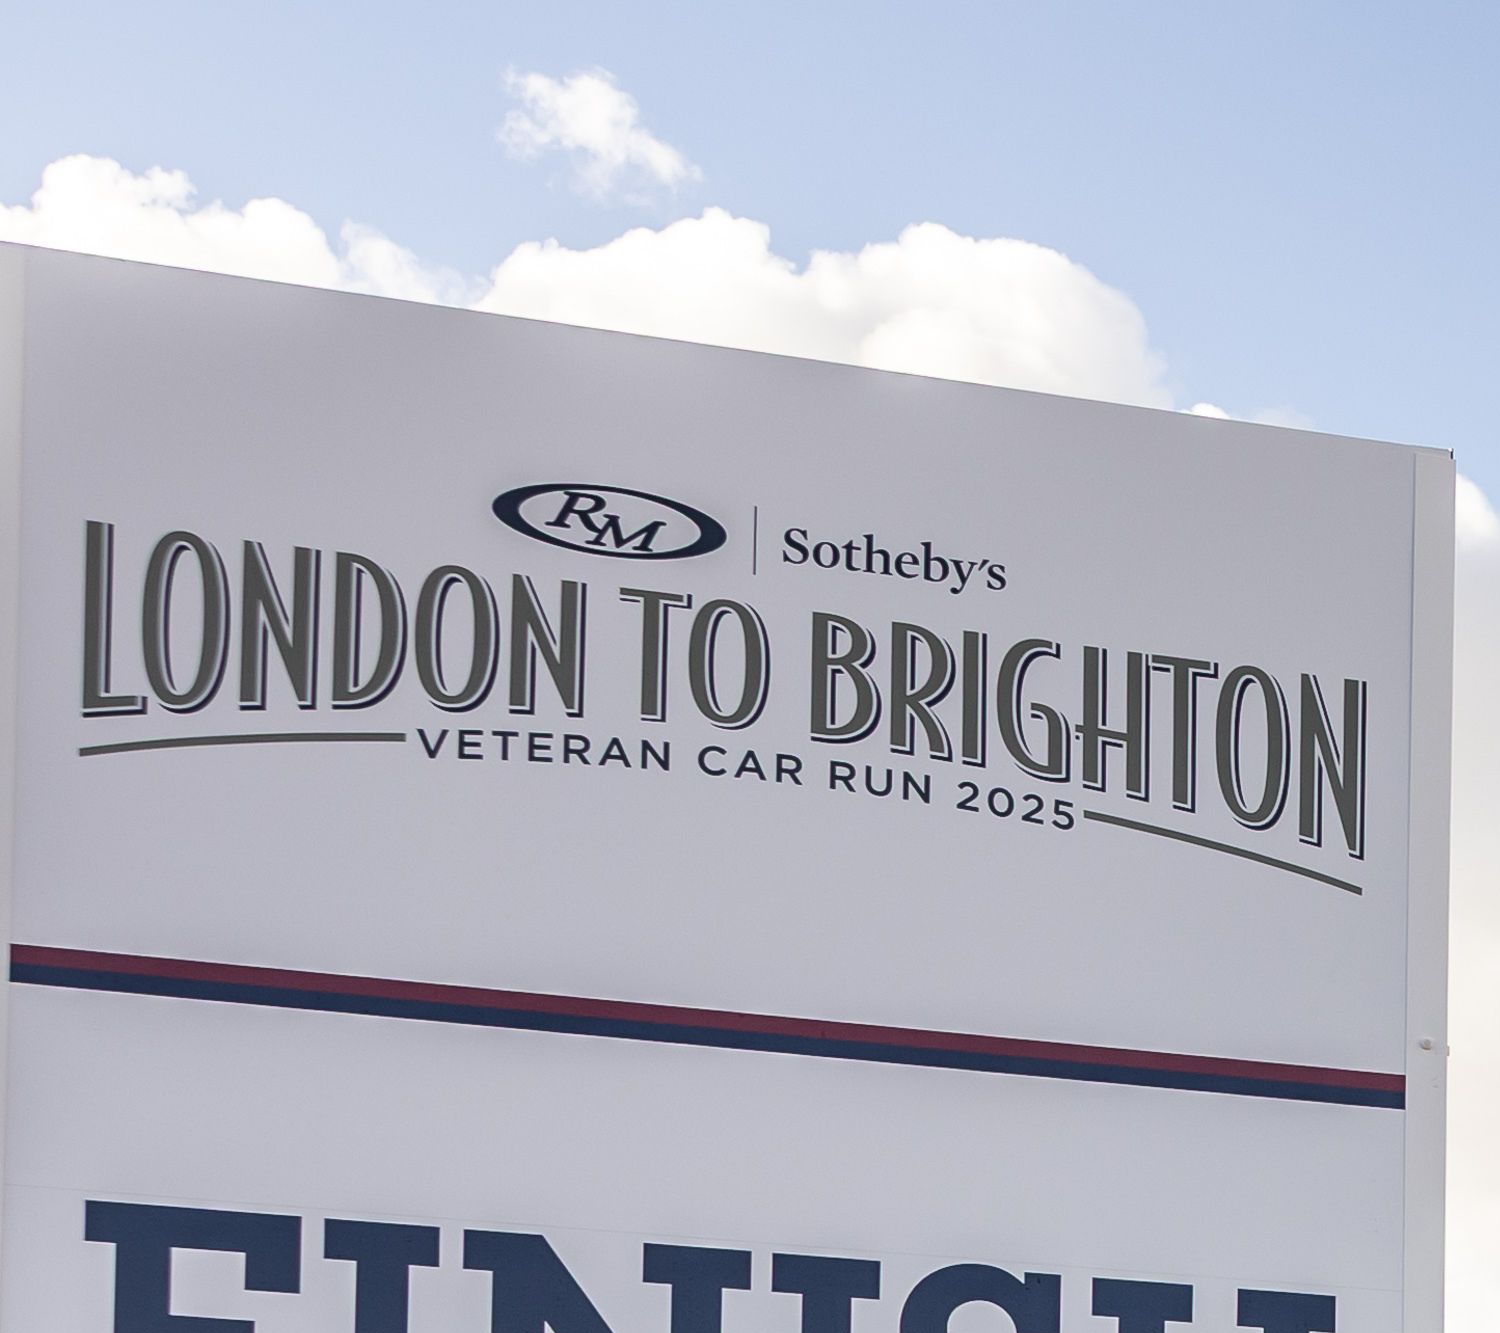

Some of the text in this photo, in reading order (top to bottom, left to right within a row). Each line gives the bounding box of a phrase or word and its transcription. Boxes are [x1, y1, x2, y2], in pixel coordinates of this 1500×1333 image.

[551, 491, 1008, 595] RM Sotheby's
[80, 519, 1368, 859] LONDON TO BRIGHTON
[417, 726, 1076, 834] VETERAN CAR RUN 2025
